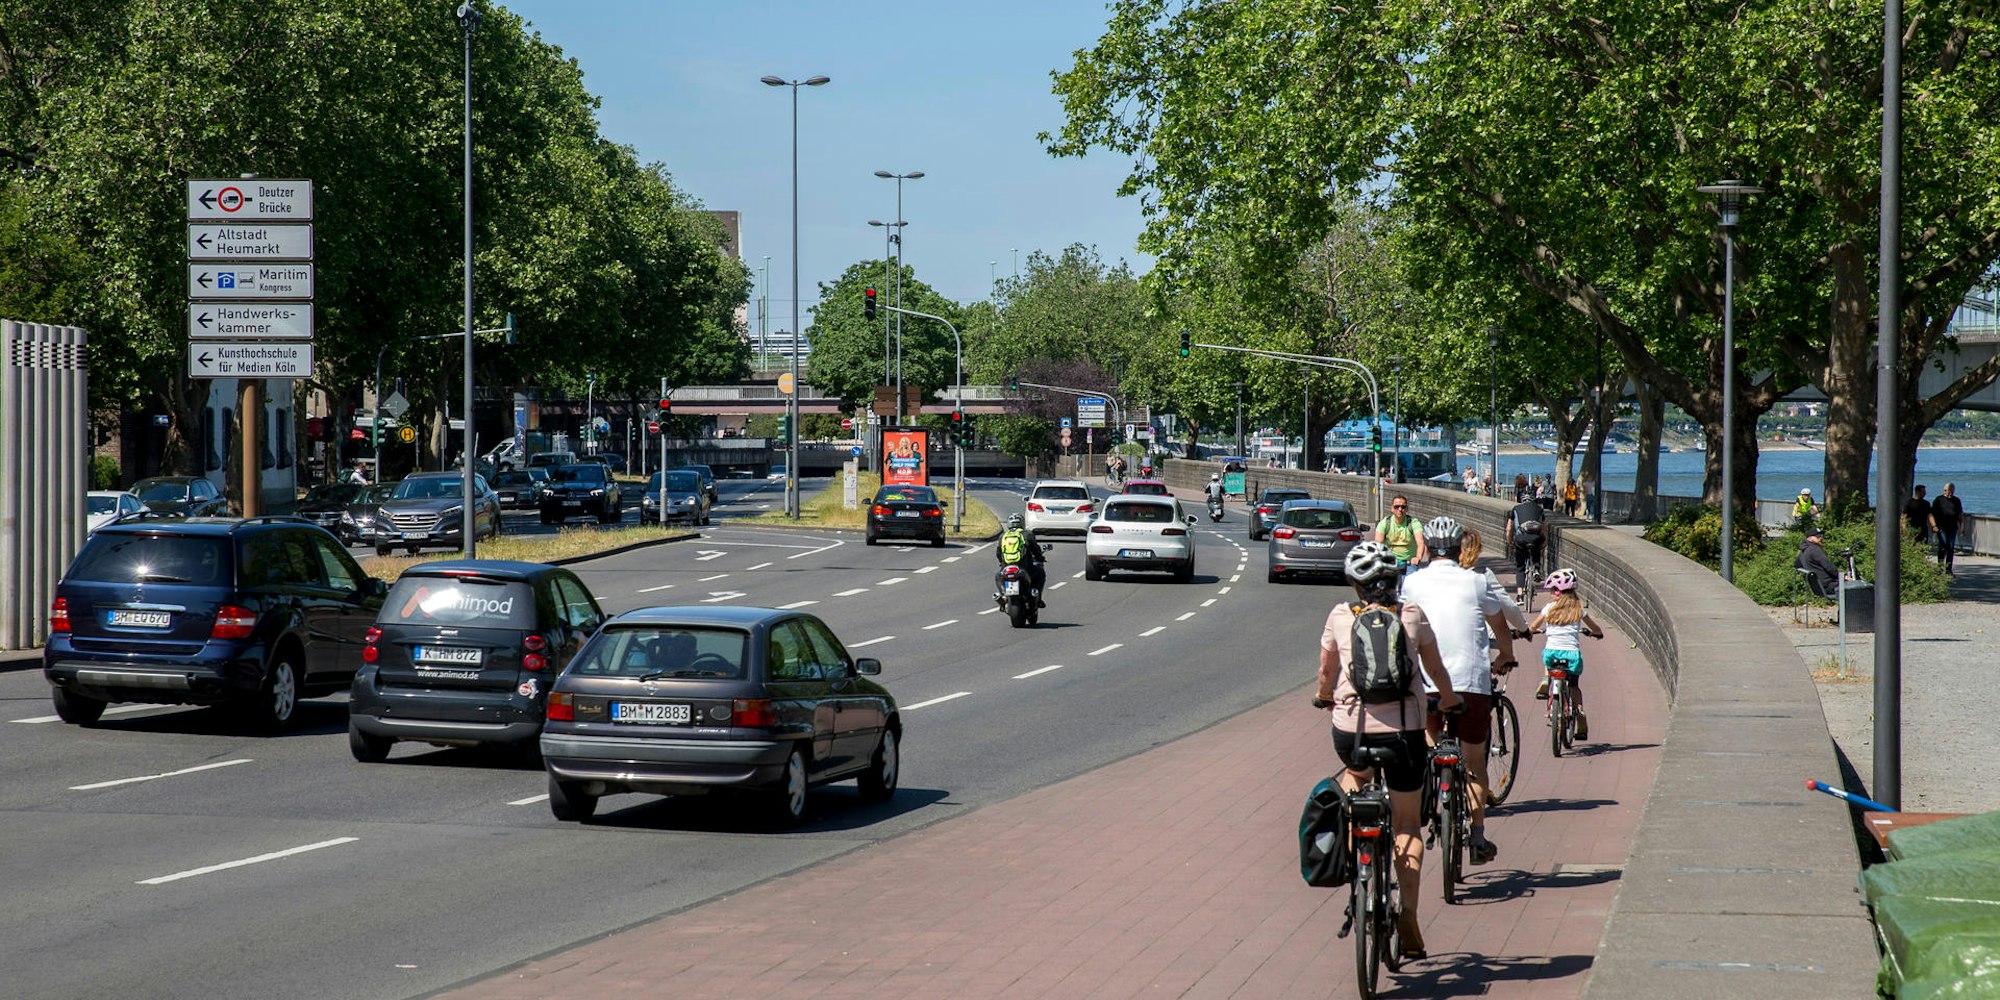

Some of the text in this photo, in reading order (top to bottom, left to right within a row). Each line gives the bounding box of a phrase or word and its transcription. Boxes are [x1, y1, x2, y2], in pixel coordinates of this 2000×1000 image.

[259, 186, 294, 198] Deutzer
[259, 202, 292, 213] Brücke
[217, 229, 267, 240] Altstadt
[217, 243, 280, 254] Heumarkt
[259, 269, 308, 280] Maritim
[259, 283, 292, 293] Kongress
[217, 308, 297, 319] Handwerks-
[218, 322, 271, 333] kammer
[218, 347, 297, 359] Kunsthochschule
[219, 361, 296, 373] für Medien Köln
[441, 594, 513, 614] nimod
[114, 612, 169, 624] BM EQ 670
[424, 648, 476, 660] K HM 872
[417, 670, 479, 680] www.animod.de
[620, 705, 688, 719] BM M 2883
